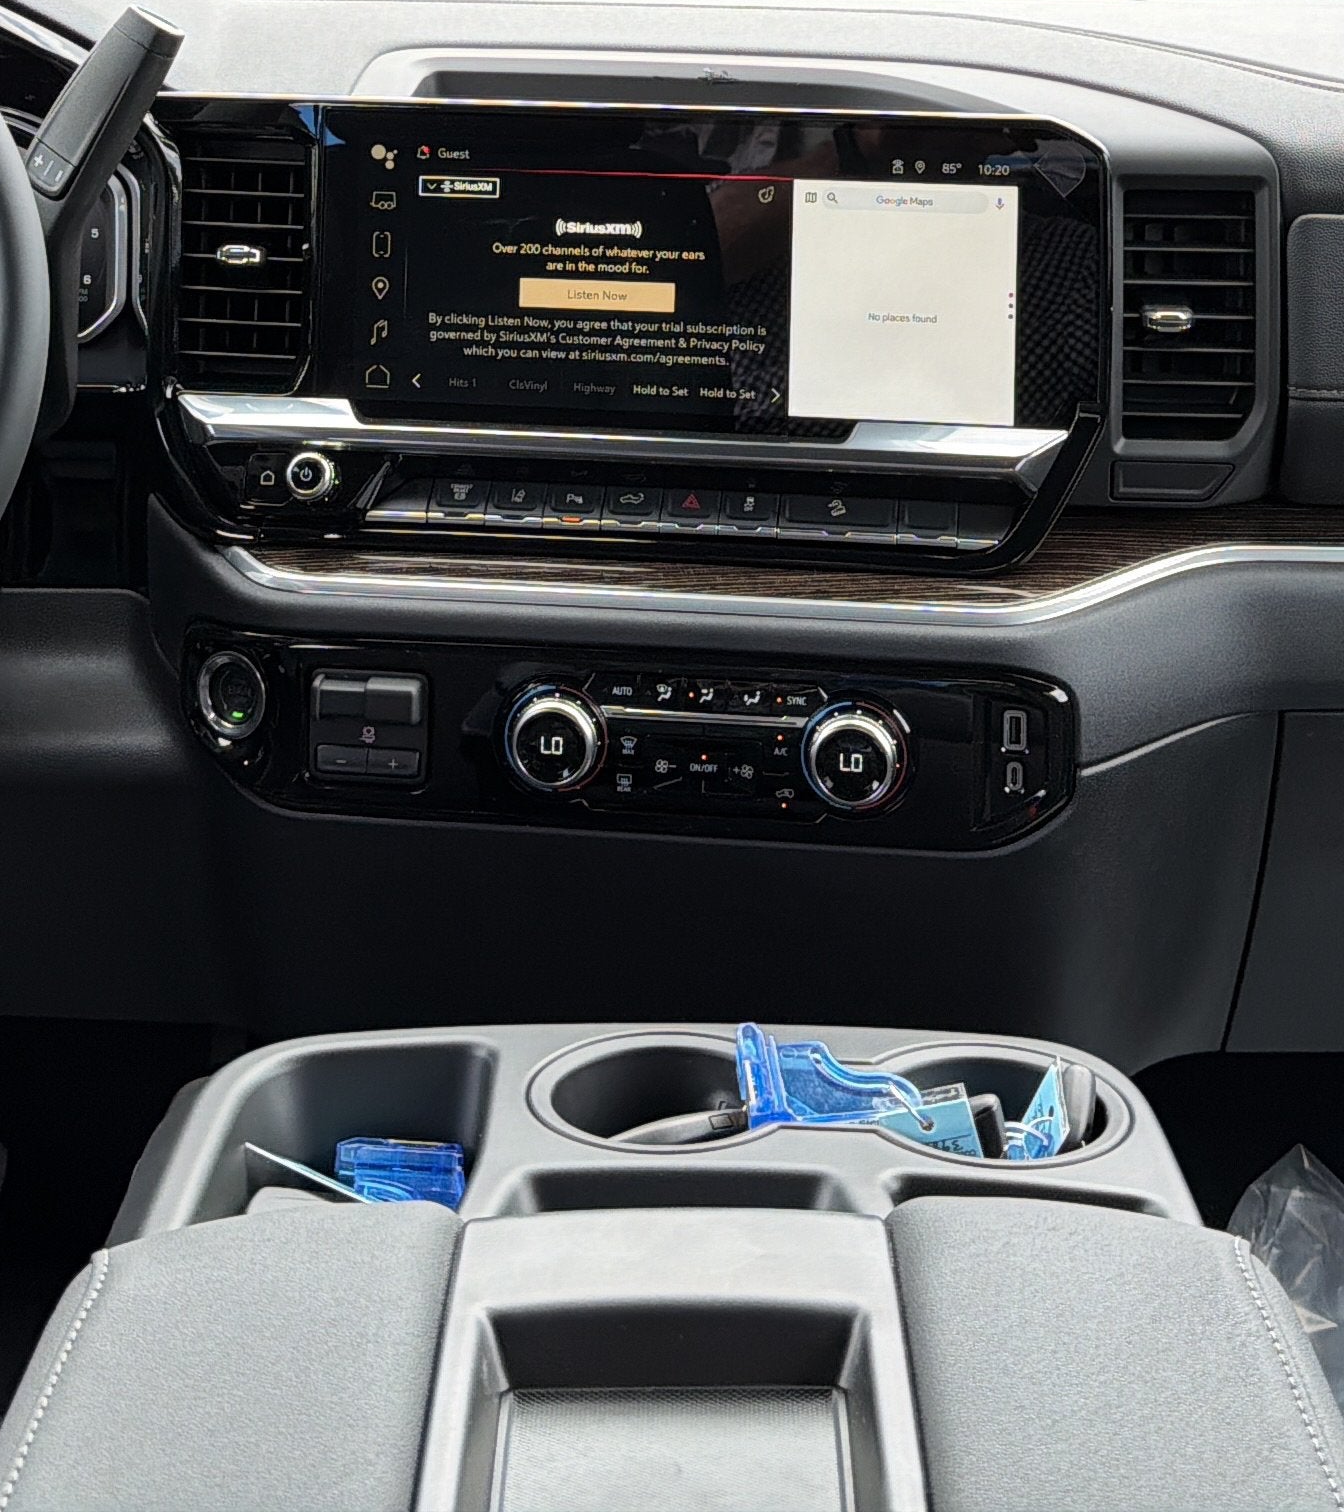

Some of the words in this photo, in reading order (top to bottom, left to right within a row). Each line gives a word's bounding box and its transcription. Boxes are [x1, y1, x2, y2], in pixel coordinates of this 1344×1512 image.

[437, 147, 471, 161] Guest
[978, 164, 1010, 176] 10:20
[876, 194, 909, 207] Google
[909, 196, 934, 208] Maps
[492, 242, 519, 255] Over
[520, 243, 541, 255] 200
[542, 244, 590, 257] channels
[591, 245, 605, 257] of
[605, 246, 654, 259] whatever
[655, 250, 680, 263] your
[681, 250, 706, 261] ears
[545, 262, 565, 272] are
[565, 261, 576, 272] in
[577, 261, 596, 273] the
[597, 262, 630, 274] mood
[630, 261, 650, 275] for.
[83, 274, 93, 286] 6
[567, 289, 599, 301] Listen
[602, 290, 628, 301] Now
[428, 312, 443, 326] By
[444, 313, 486, 328] clicking
[488, 314, 521, 327] Listen
[523, 316, 552, 329] Now,
[553, 319, 574, 331] you
[576, 320, 608, 333] agree
[610, 318, 632, 331] that
[634, 322, 660, 335] your
[661, 321, 684, 333] trial
[686, 322, 755, 337] subscription
[757, 325, 767, 337] is
[867, 312, 881, 322] No
[882, 313, 911, 325] places
[912, 313, 938, 324] found
[429, 329, 482, 342] governed
[483, 329, 497, 344] by
[499, 331, 557, 343] SiriusXM's
[558, 333, 613, 346] Customer
[614, 335, 676, 349] Agreement
[677, 337, 688, 349] &
[689, 338, 730, 353] Privacy
[731, 339, 765, 355] Policy
[463, 345, 496, 357] which
[497, 348, 518, 360] you
[519, 348, 540, 358] can
[541, 348, 567, 360] view
[568, 349, 580, 360] at
[582, 349, 730, 367] siriusxm.com/agreements.
[448, 377, 469, 388] Hits
[508, 379, 549, 393] ClsVinyl
[573, 382, 617, 396] Highway
[632, 384, 657, 396] Hold
[659, 386, 670, 397] to
[671, 386, 689, 397] Set
[699, 387, 724, 399] Hold
[725, 389, 737, 399] to
[738, 389, 756, 400] Set
[611, 686, 633, 697] AUTO
[786, 696, 808, 707] SYNC
[540, 736, 565, 755] LO
[773, 746, 789, 757] A/C
[689, 762, 719, 774] ON/OFF
[839, 753, 864, 773] LO
